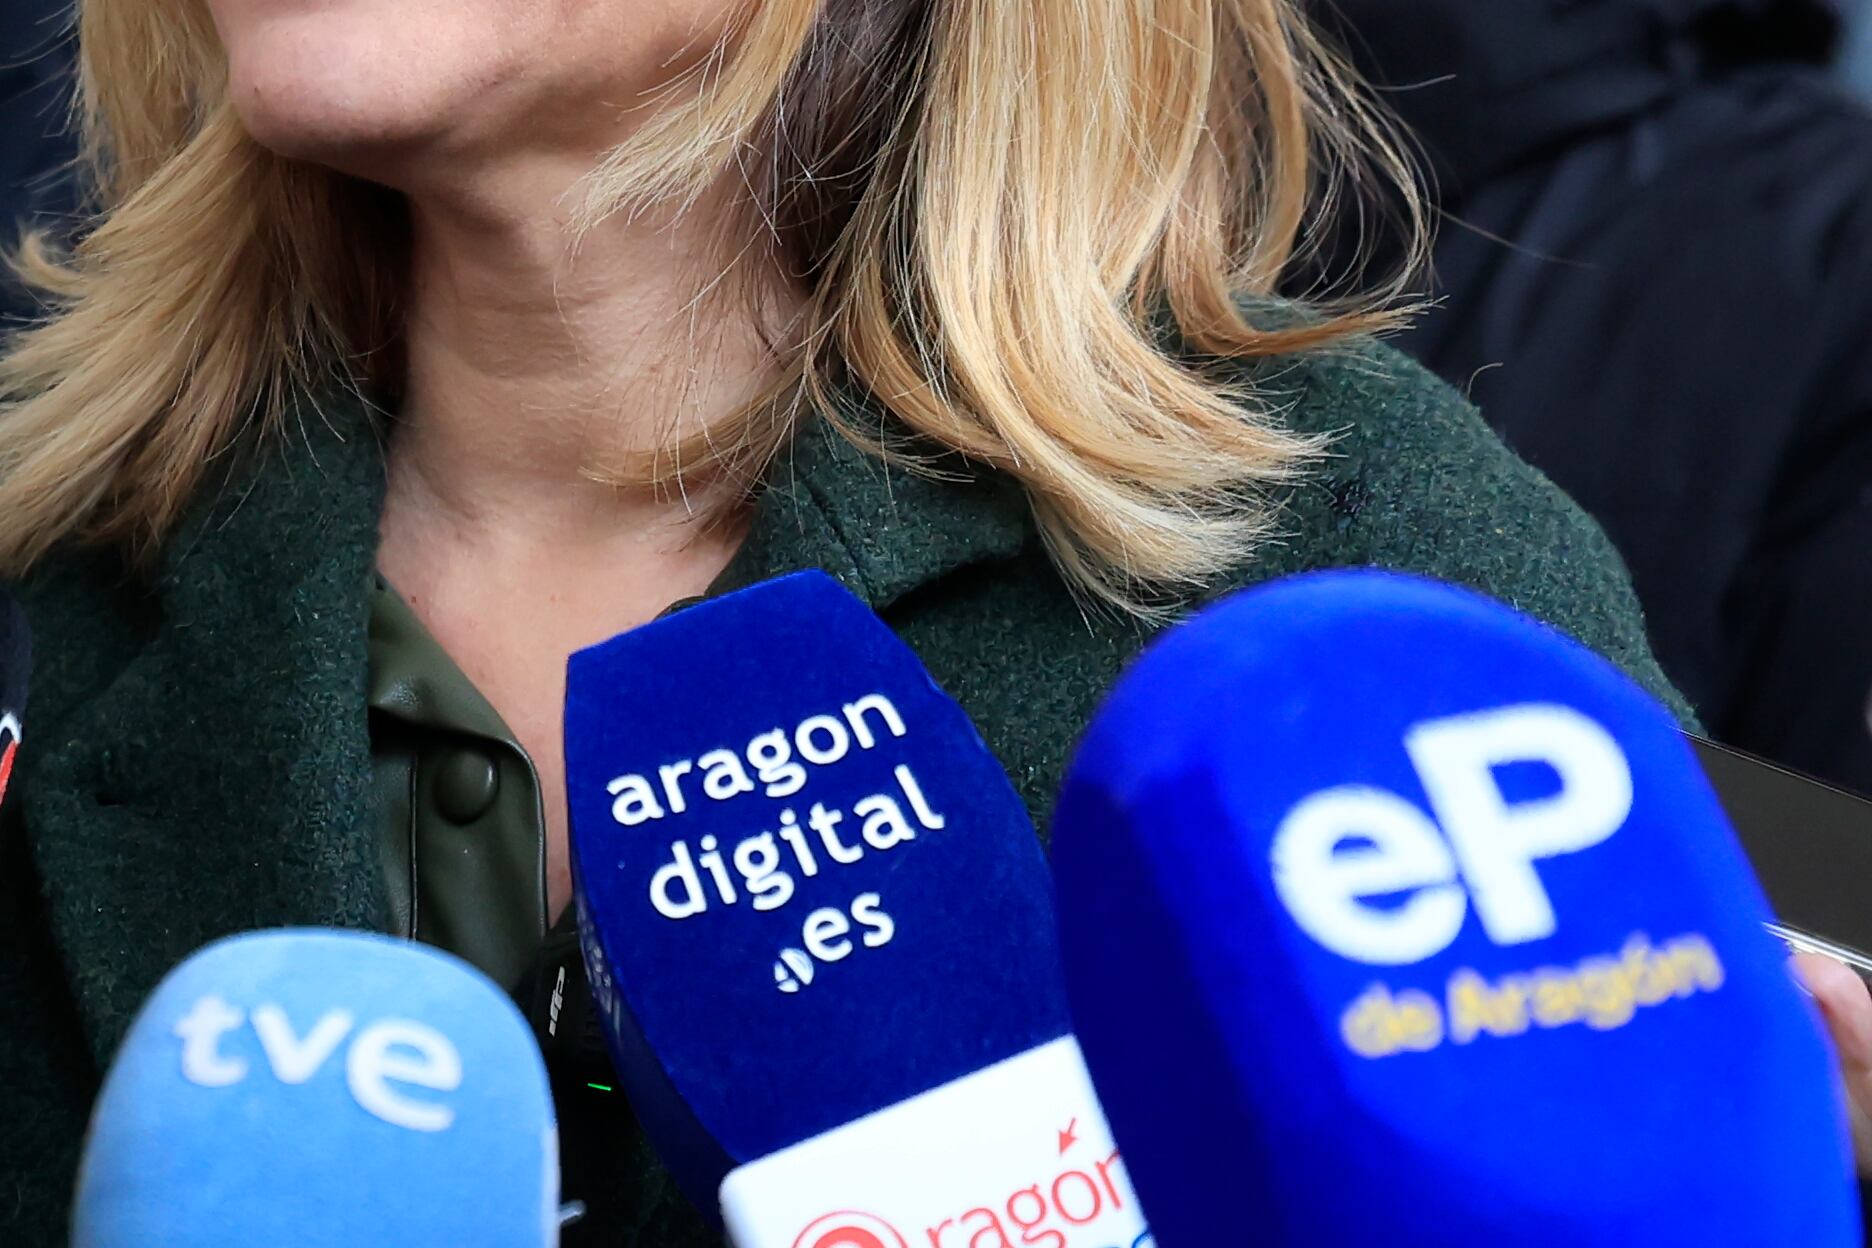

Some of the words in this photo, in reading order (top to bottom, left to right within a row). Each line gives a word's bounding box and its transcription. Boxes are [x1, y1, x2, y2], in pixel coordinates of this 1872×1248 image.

[606, 693, 907, 827] aragon
[648, 764, 946, 920] digital
[1270, 701, 1634, 966] eP
[173, 993, 463, 1132] tve
[1341, 984, 1445, 1060] de
[1446, 933, 1725, 1043] Aragón
